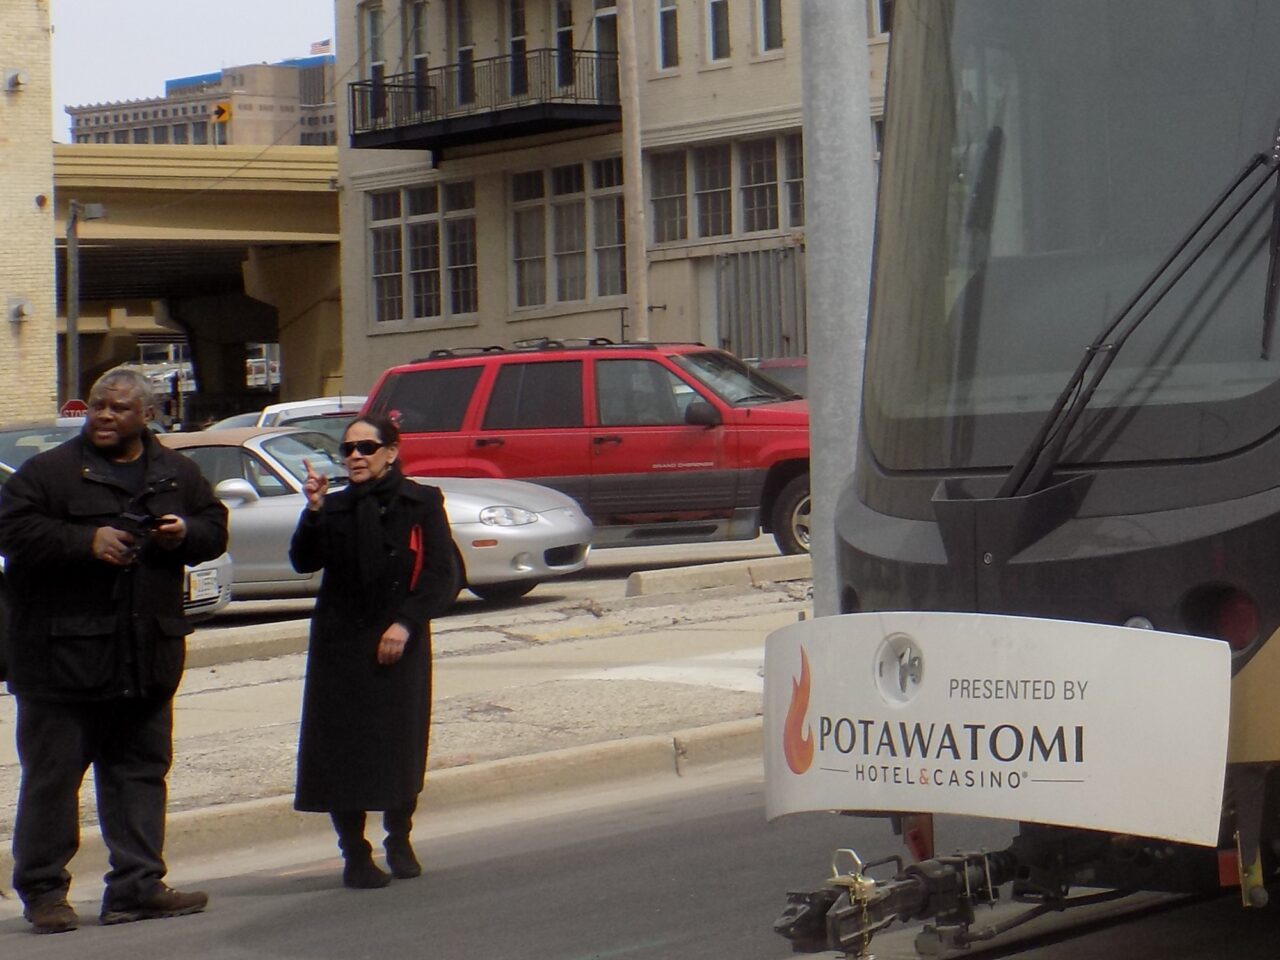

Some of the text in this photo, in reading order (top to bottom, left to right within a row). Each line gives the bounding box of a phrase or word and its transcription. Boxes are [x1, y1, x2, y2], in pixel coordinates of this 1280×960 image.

[948, 678, 1089, 701] PRESENTED BY
[819, 716, 1084, 763] POTAWATOMI
